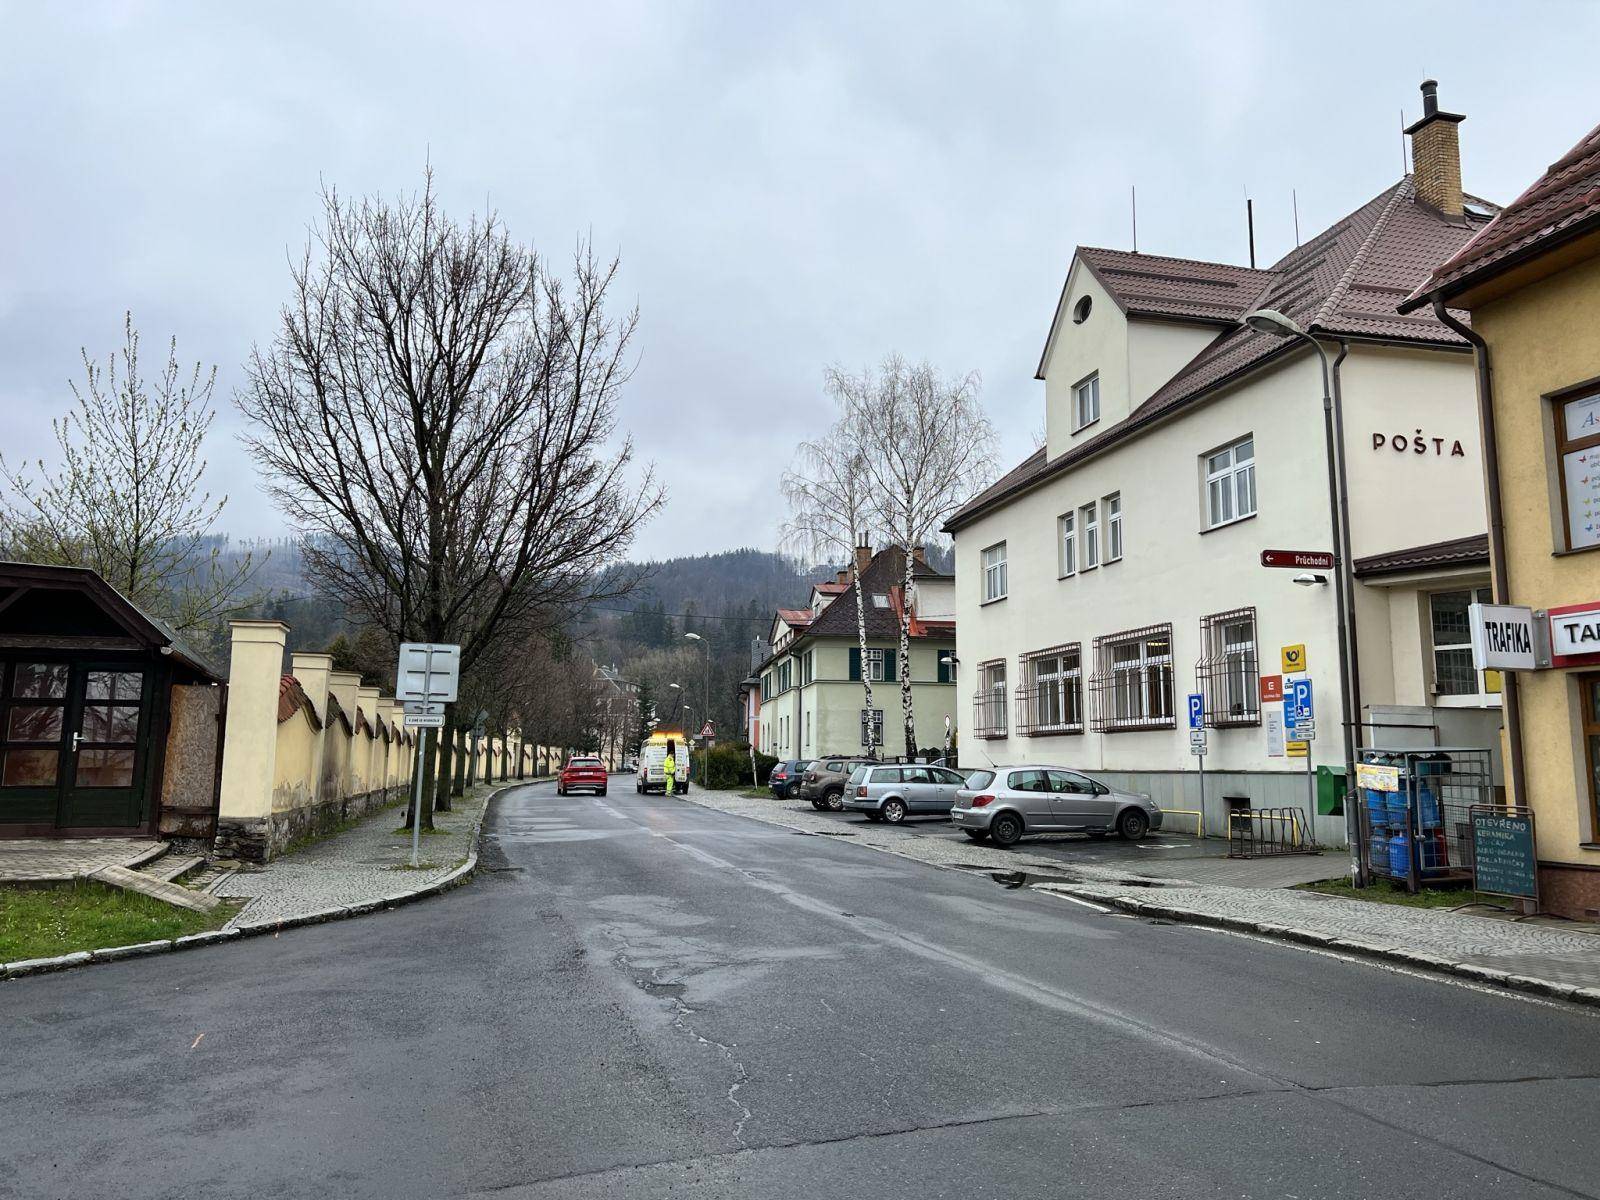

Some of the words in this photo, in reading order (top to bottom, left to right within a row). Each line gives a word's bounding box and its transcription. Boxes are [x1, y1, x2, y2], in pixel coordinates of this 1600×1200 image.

[1372, 428, 1465, 457] POŠTA
[1295, 555, 1329, 566] Průchodní
[1485, 621, 1532, 653] TRAFIKA
[1563, 622, 1600, 643] TA
[1475, 818, 1526, 832] OTEVŘENO
